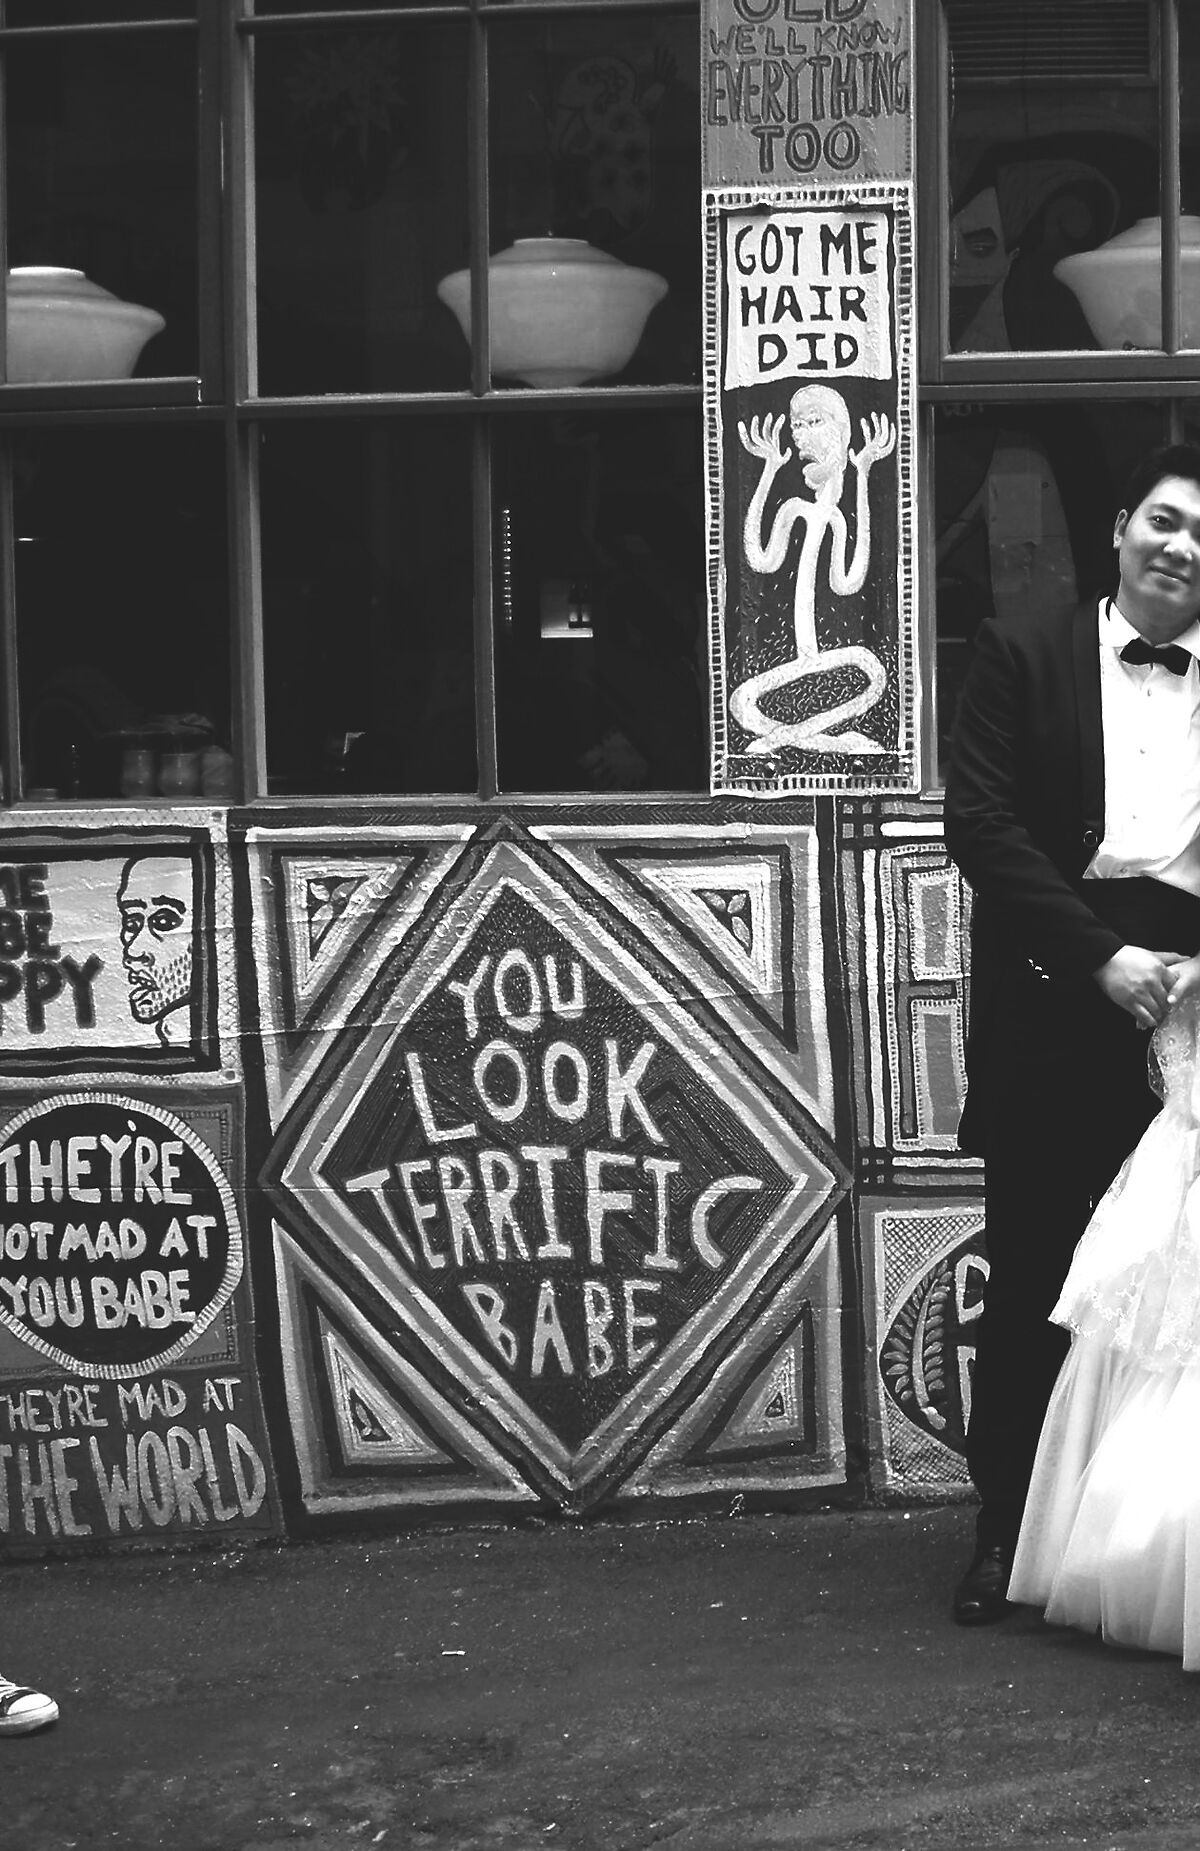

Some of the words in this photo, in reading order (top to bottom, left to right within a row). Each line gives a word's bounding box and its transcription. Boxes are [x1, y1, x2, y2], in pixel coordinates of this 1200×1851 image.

[709, 24, 808, 55] WE'LL
[814, 17, 903, 54] KNOW
[707, 52, 911, 126] EVERYTHING
[751, 121, 861, 173] TOO
[735, 224, 803, 276] GOT
[820, 222, 878, 276] ME
[740, 286, 867, 327] HAIR
[758, 333, 859, 372] DID
[448, 948, 586, 1039] YOU
[405, 1040, 668, 1146] LOOK
[346, 1144, 763, 1270] TERRIFIC
[0, 1221, 54, 1261] OT
[58, 1218, 147, 1262] MAD
[159, 1215, 217, 1260] AT
[0, 1275, 84, 1328] YOU
[91, 1269, 196, 1330] BABE
[462, 1279, 662, 1378] BABE
[117, 1378, 188, 1428] MAD
[203, 1377, 241, 1413] AT
[89, 1423, 266, 1535] WORLD
